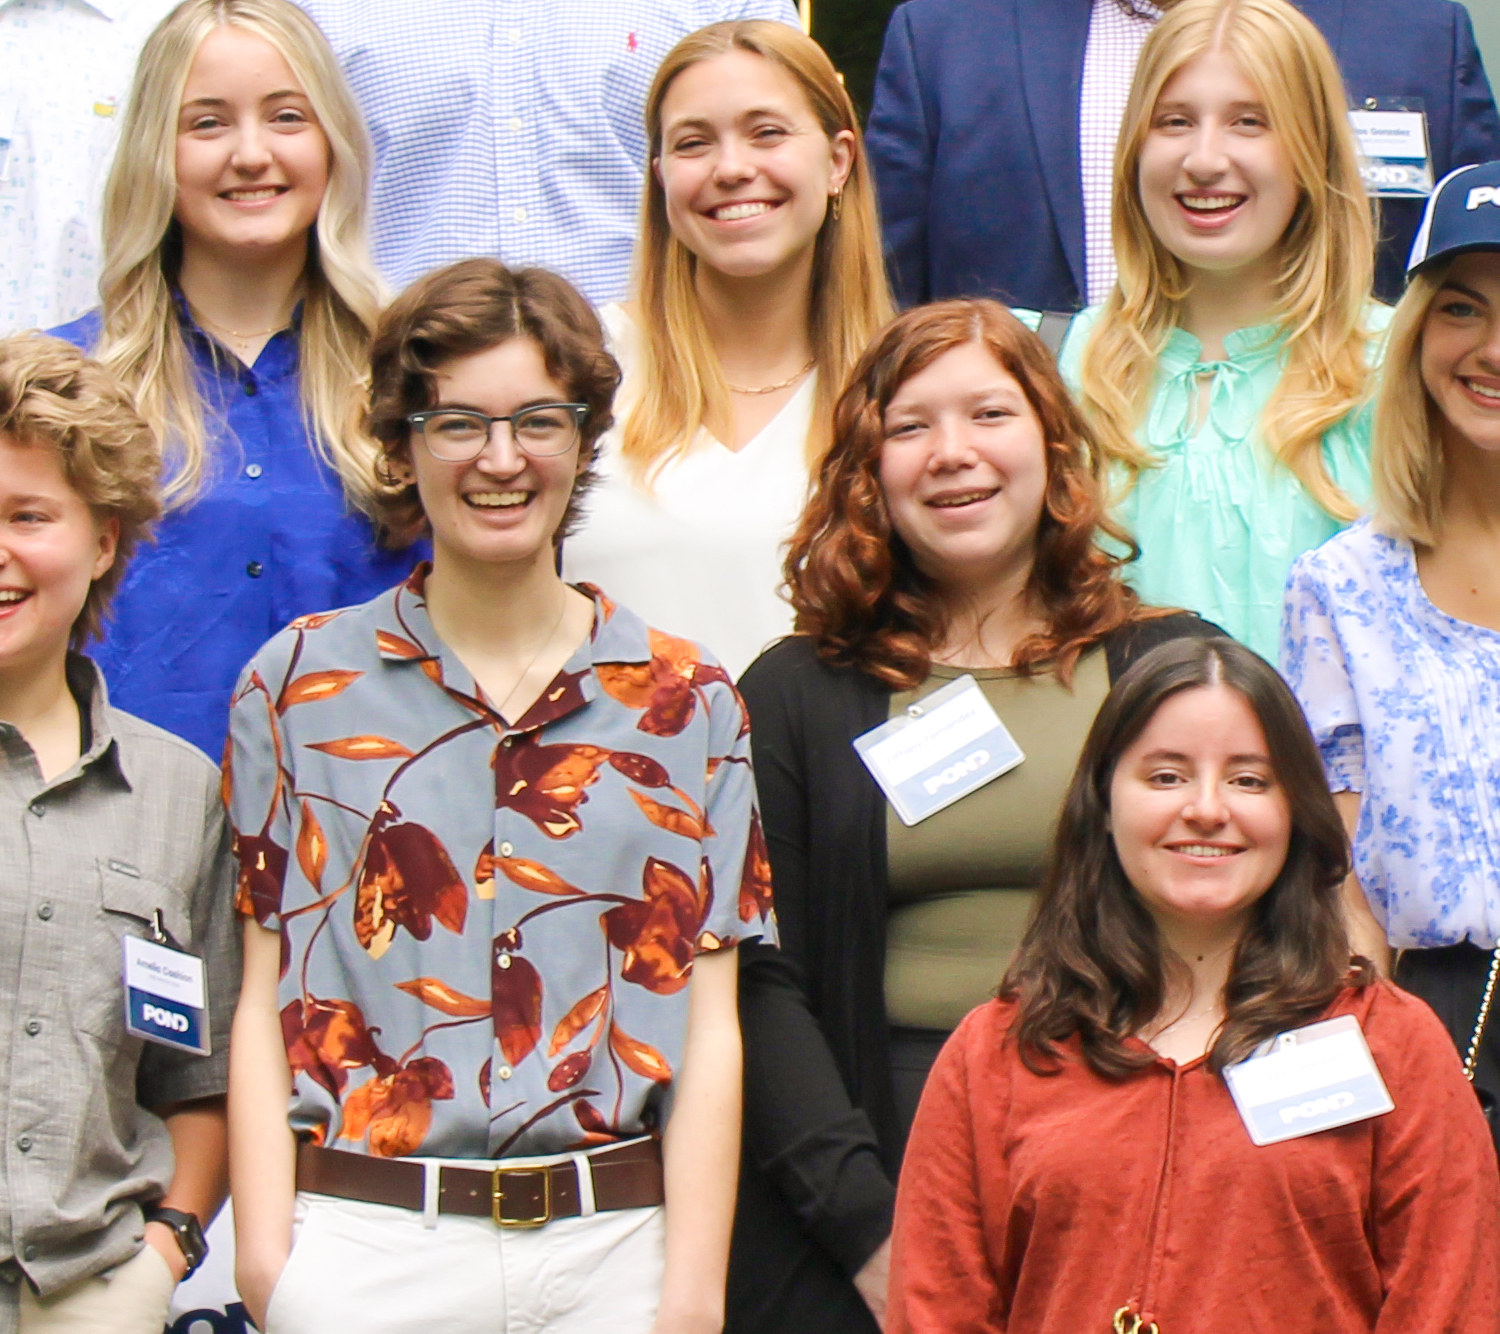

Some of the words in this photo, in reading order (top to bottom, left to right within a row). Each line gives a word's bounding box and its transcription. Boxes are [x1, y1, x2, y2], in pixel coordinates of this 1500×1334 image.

[923, 749, 992, 795] POND
[143, 1003, 190, 1033] POND
[1278, 1091, 1356, 1125] POND
